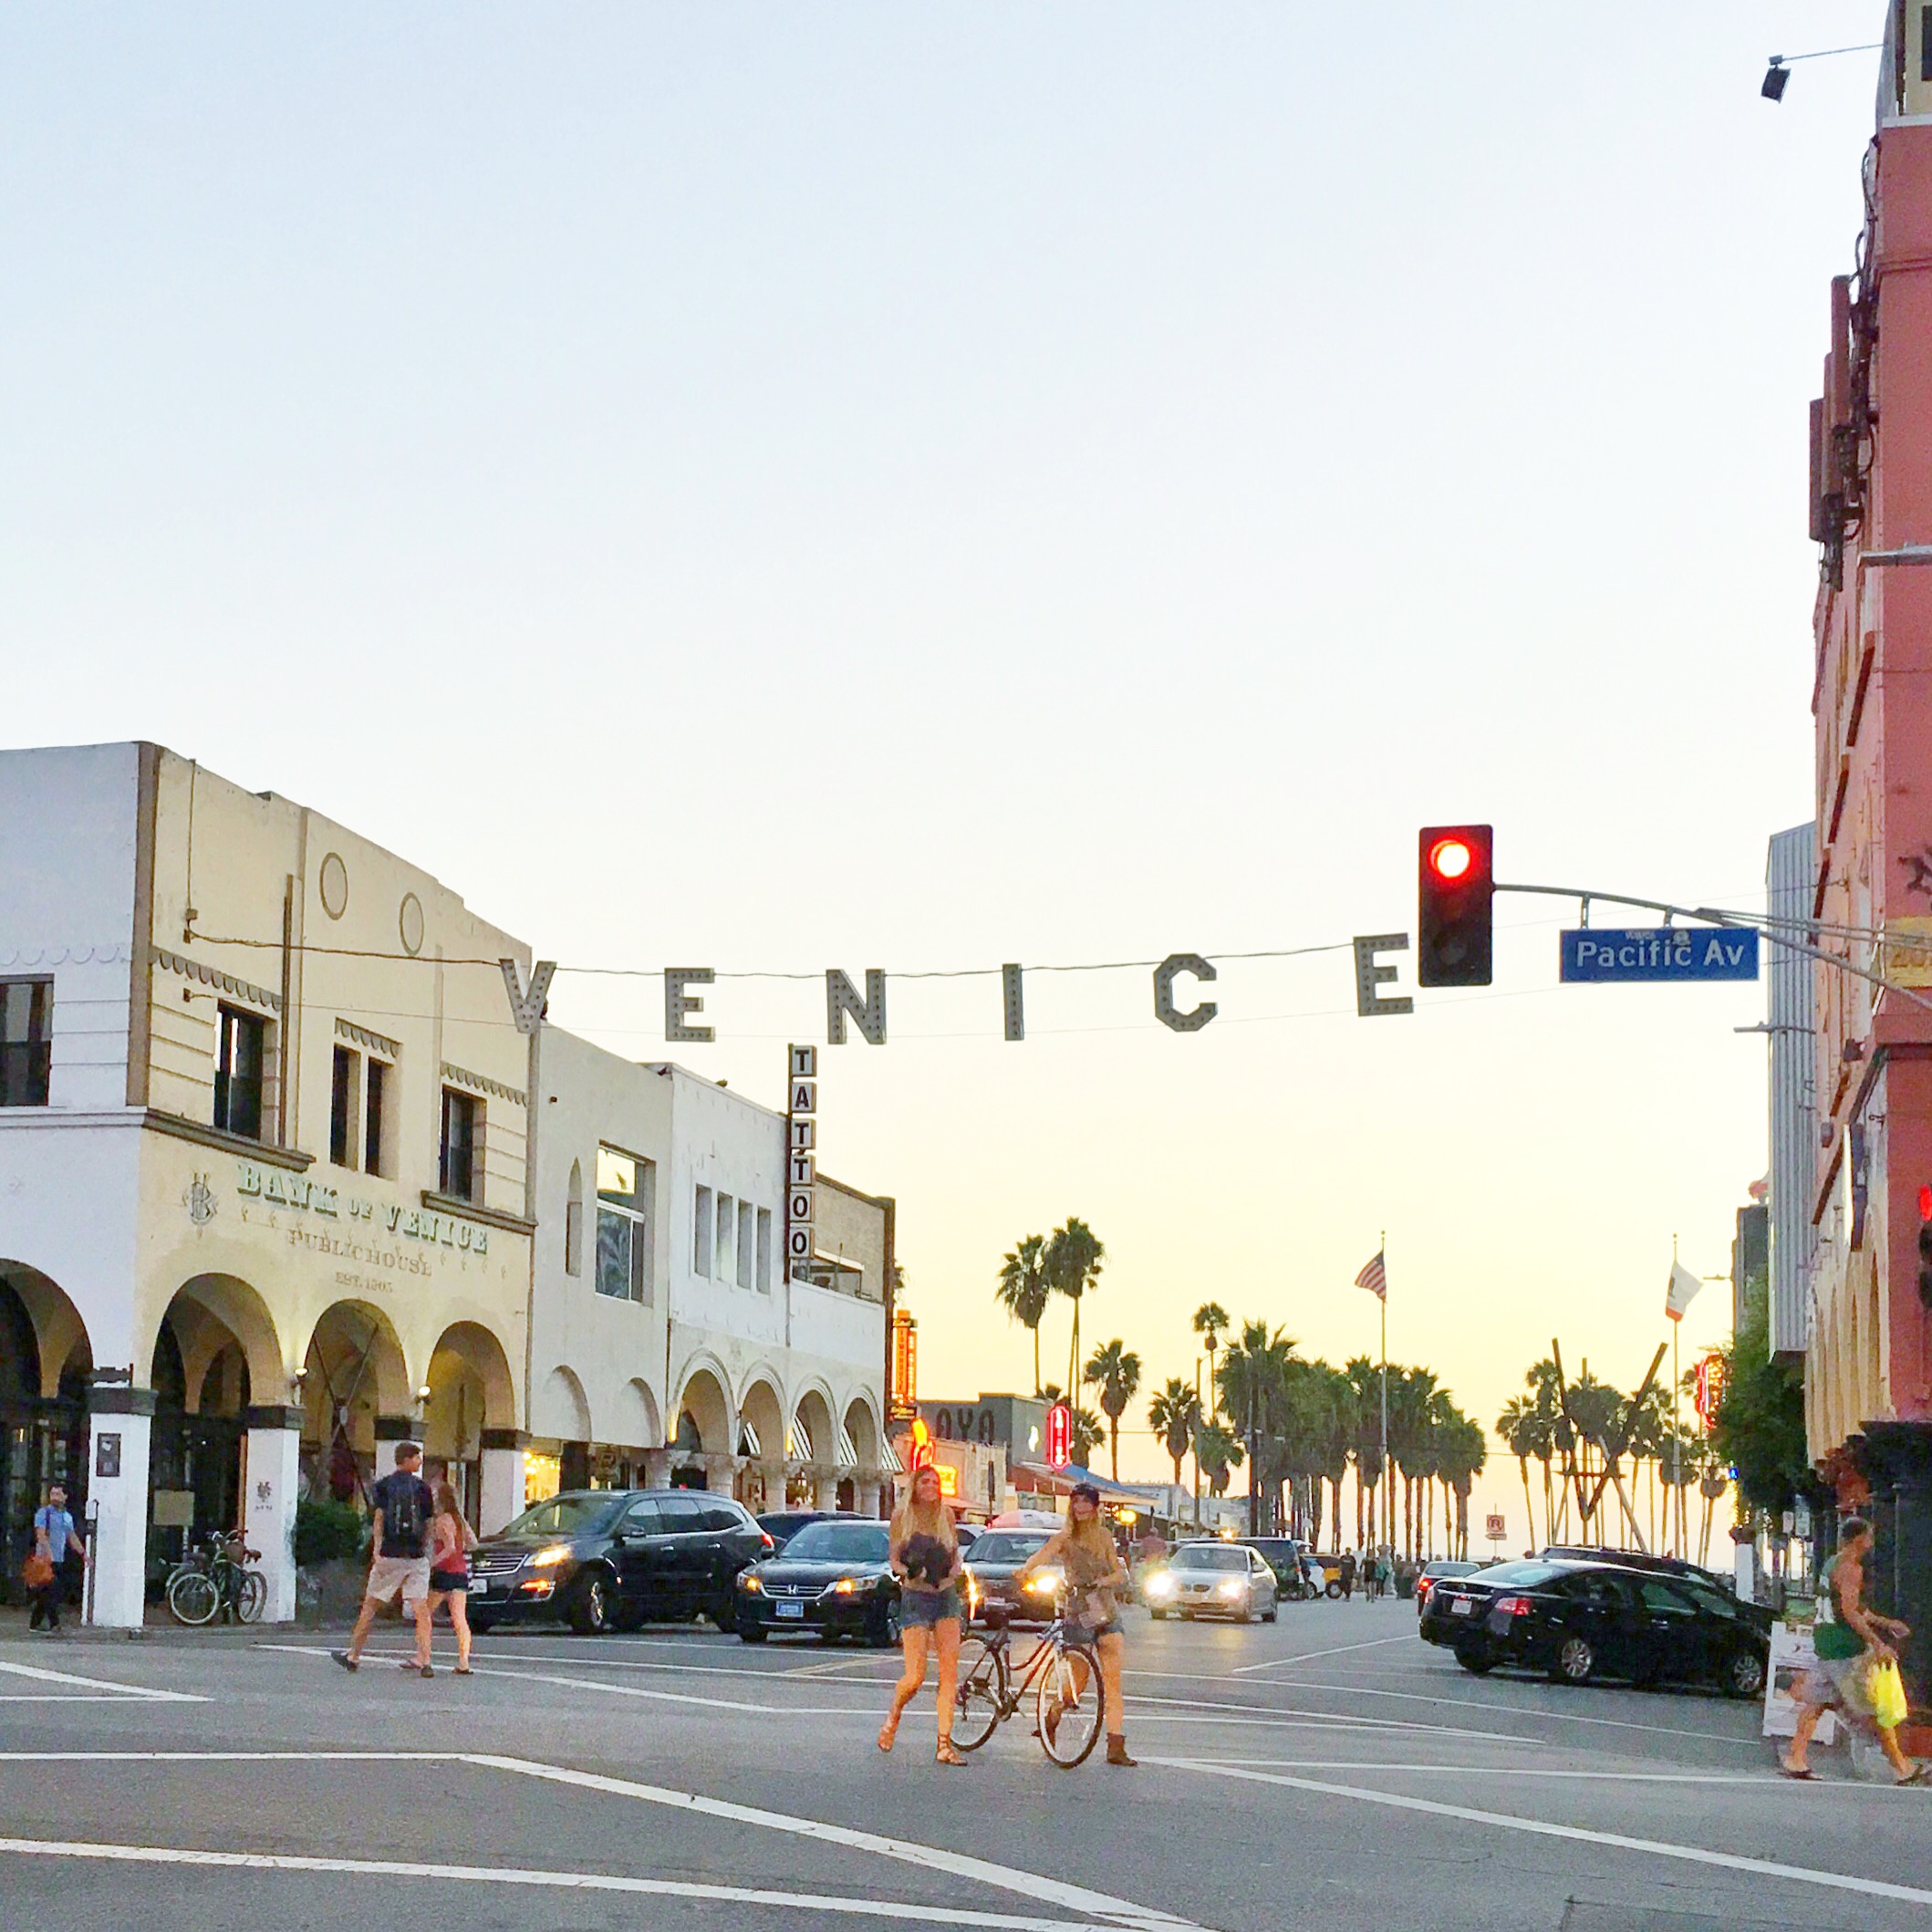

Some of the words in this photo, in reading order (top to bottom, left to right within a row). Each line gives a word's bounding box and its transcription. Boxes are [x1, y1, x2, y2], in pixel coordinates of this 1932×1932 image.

[498, 932, 1414, 1044] VENICE
[1576, 940, 1692, 968] Pacific
[1703, 938, 1744, 967] Av
[791, 1049, 810, 1255] TATTOO
[236, 1163, 340, 1218] BANK
[381, 1200, 489, 1256] VENICE
[286, 1228, 363, 1261] PUBLIC
[365, 1247, 433, 1277] HOUSE
